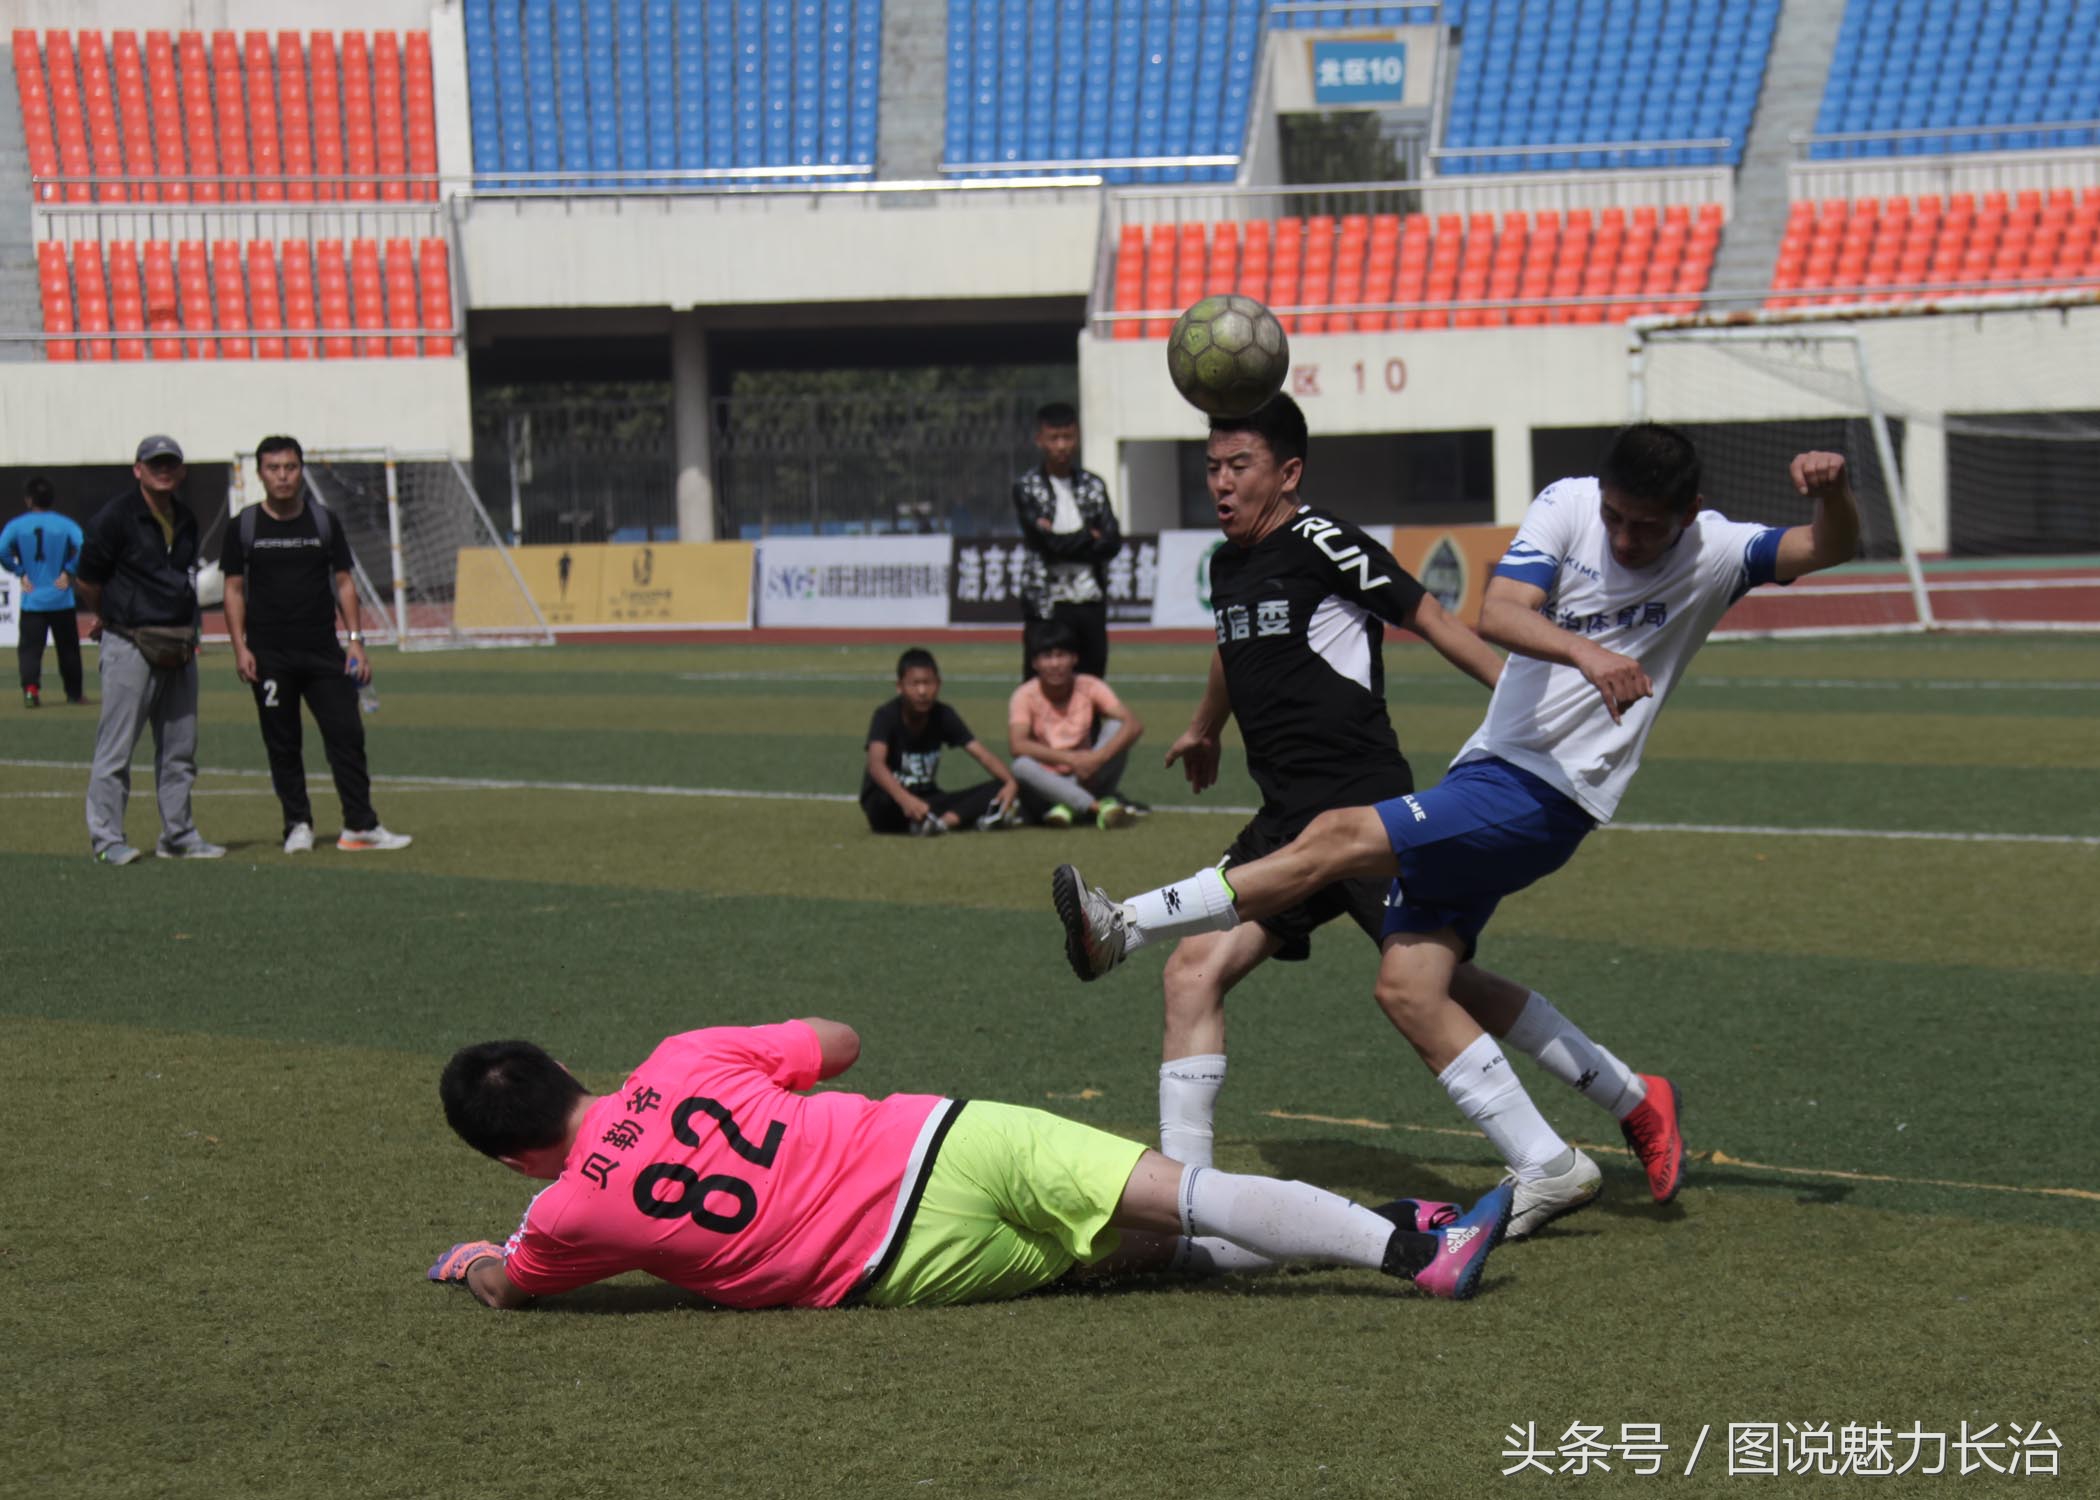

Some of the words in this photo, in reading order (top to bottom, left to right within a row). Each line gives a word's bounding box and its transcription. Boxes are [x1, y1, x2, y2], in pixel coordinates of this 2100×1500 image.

[34, 527, 45, 562] 1
[263, 679, 279, 707] 2
[580, 1085, 662, 1190] 贝勒爷
[632, 1096, 788, 1235] 82
[1448, 1226, 1481, 1254] adidas
